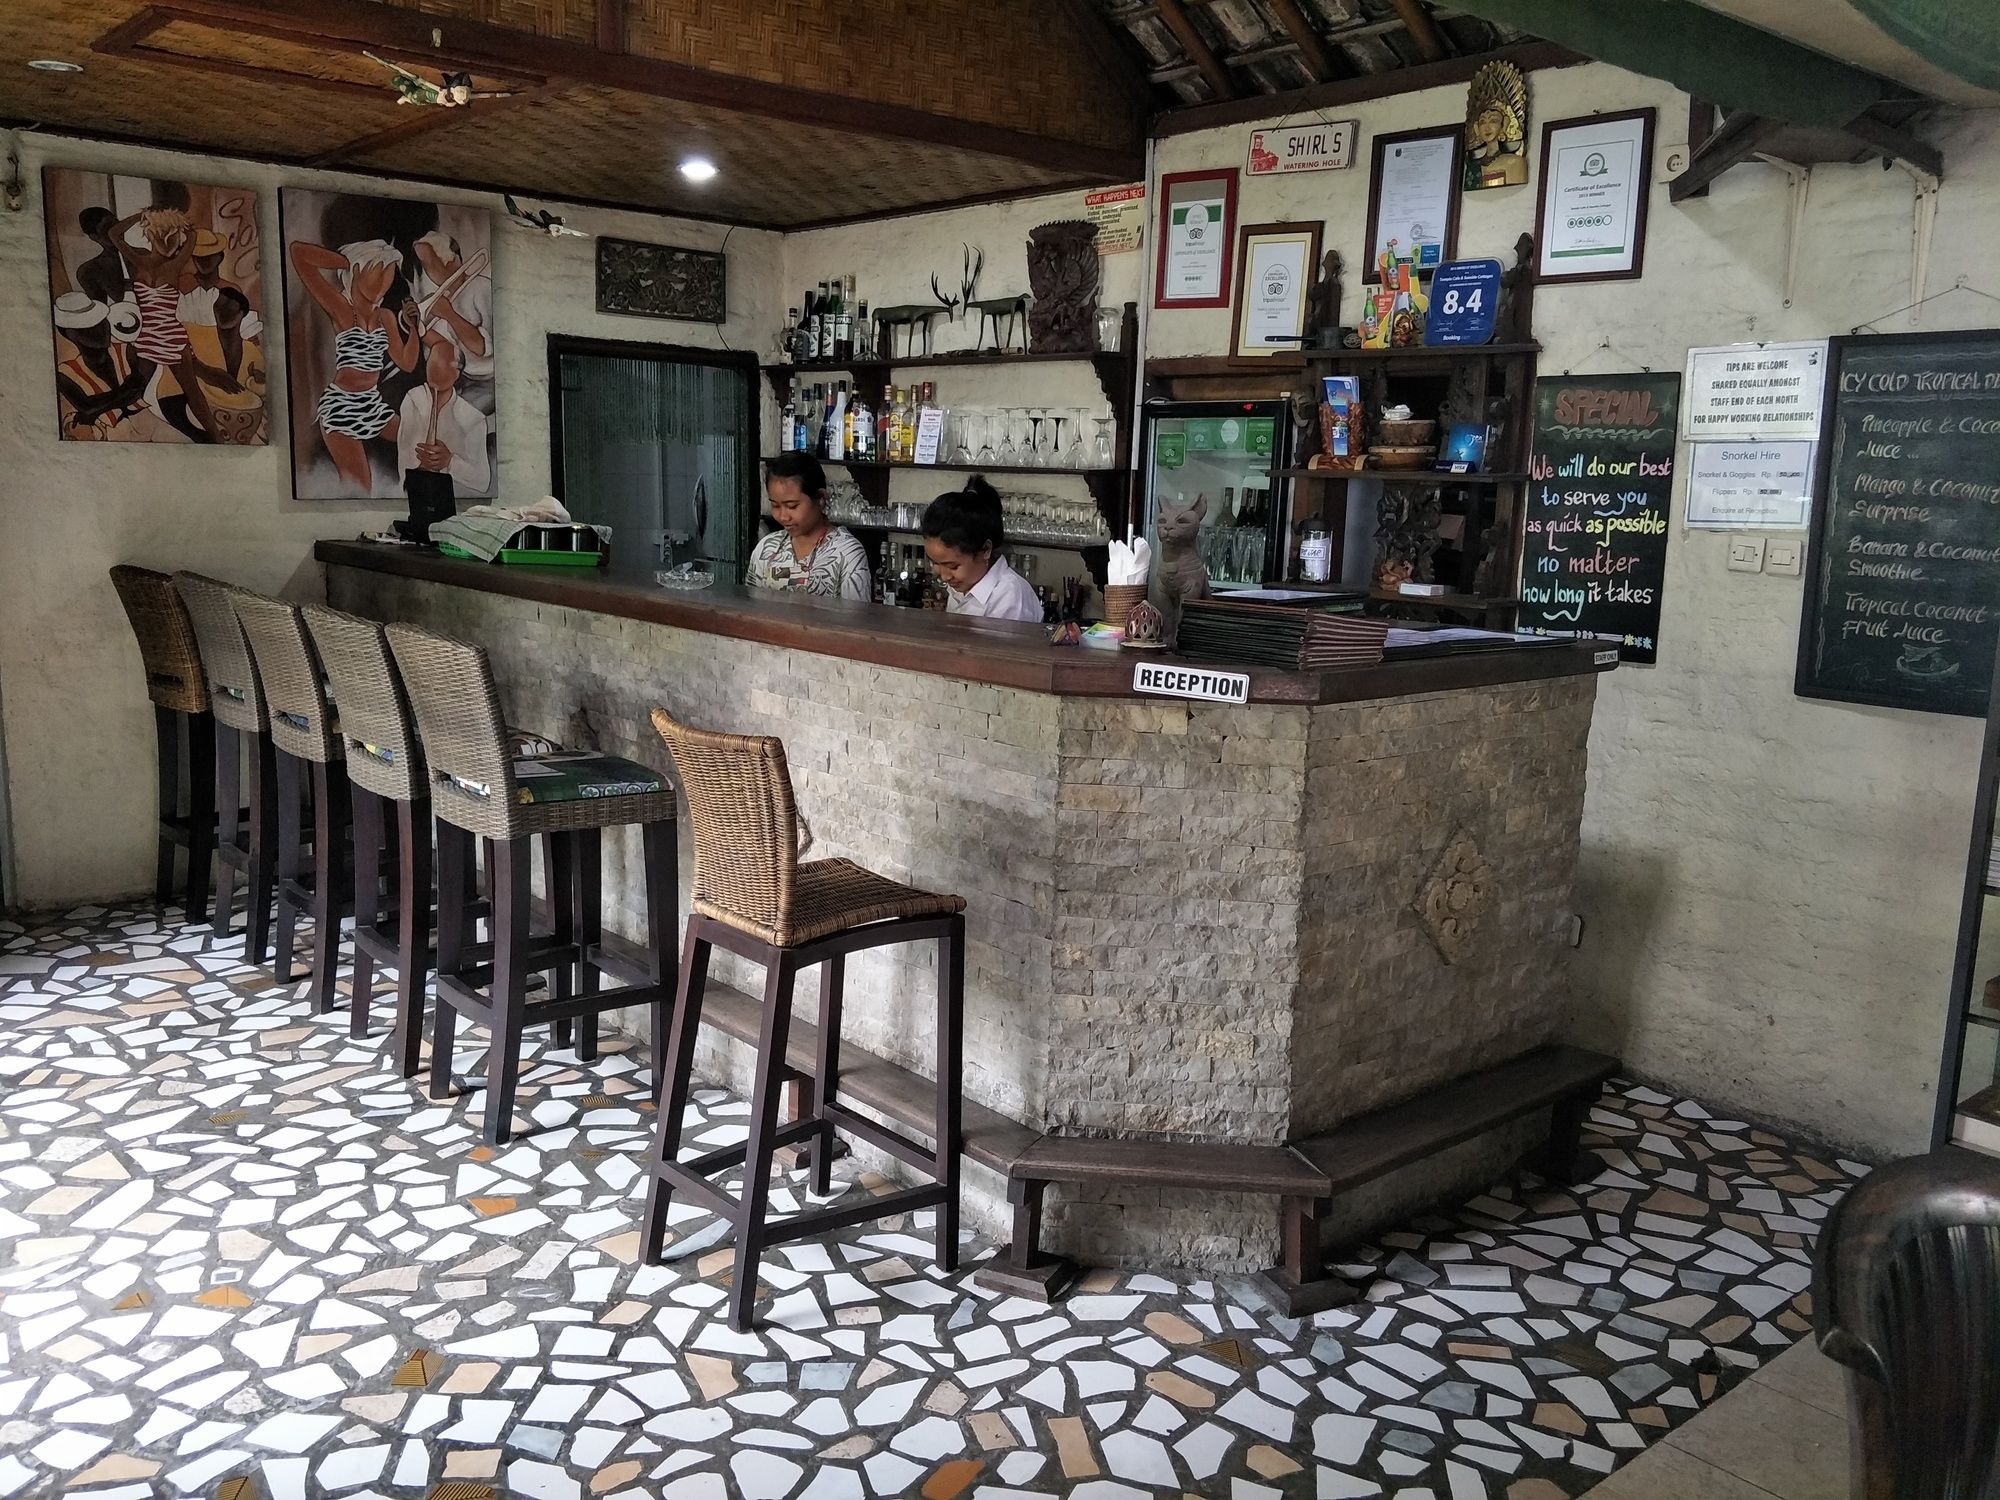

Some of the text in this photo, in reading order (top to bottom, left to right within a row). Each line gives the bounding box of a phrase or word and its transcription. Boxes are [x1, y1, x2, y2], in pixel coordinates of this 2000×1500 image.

[1284, 159, 1342, 170] WATERING HOLE
[1086, 194, 1102, 204] WHAT
[1130, 188, 1144, 198] NEXT
[1596, 182, 1622, 190] Excellence
[1443, 289, 1482, 315] 8.4
[1726, 360, 1788, 372] TIPS ARE WELCOME
[1712, 377, 1801, 390] SHARED EQUALLY AMONGST
[1840, 372, 1867, 392] ICY
[1868, 372, 1909, 392] COLD
[1914, 370, 1982, 391] TROPICAL
[1554, 389, 1659, 426] SPECIAL
[1710, 394, 1798, 406] STAFF END OF EACH MONTH
[1694, 412, 1814, 424] FOR HAPPY WORKING RELATIONSHIPS
[1862, 414, 1932, 438] Pineapple
[1938, 416, 1956, 434] &
[1721, 450, 1781, 460] Snorkel Hire
[1856, 440, 1902, 458] Juice
[1532, 452, 1672, 480] We will do our best
[1729, 472, 1756, 480] Goggles
[1712, 488, 1737, 496] Flippers
[1854, 472, 1906, 498] Mango
[1912, 478, 1927, 496] &
[1541, 486, 1648, 515] to serve you
[1848, 500, 1935, 525] Surprise
[1527, 508, 1667, 552] as quick as possible
[1848, 535, 1909, 557] Banana
[1914, 542, 1928, 558] &
[1538, 546, 1640, 575] no matter
[1848, 558, 1930, 581] Smoothie
[1522, 578, 1654, 622] how long it takes
[1846, 592, 1988, 624] Tropical Coconut
[1842, 618, 1950, 644] Fruit Juice
[1140, 668, 1244, 698] RECEPTION
